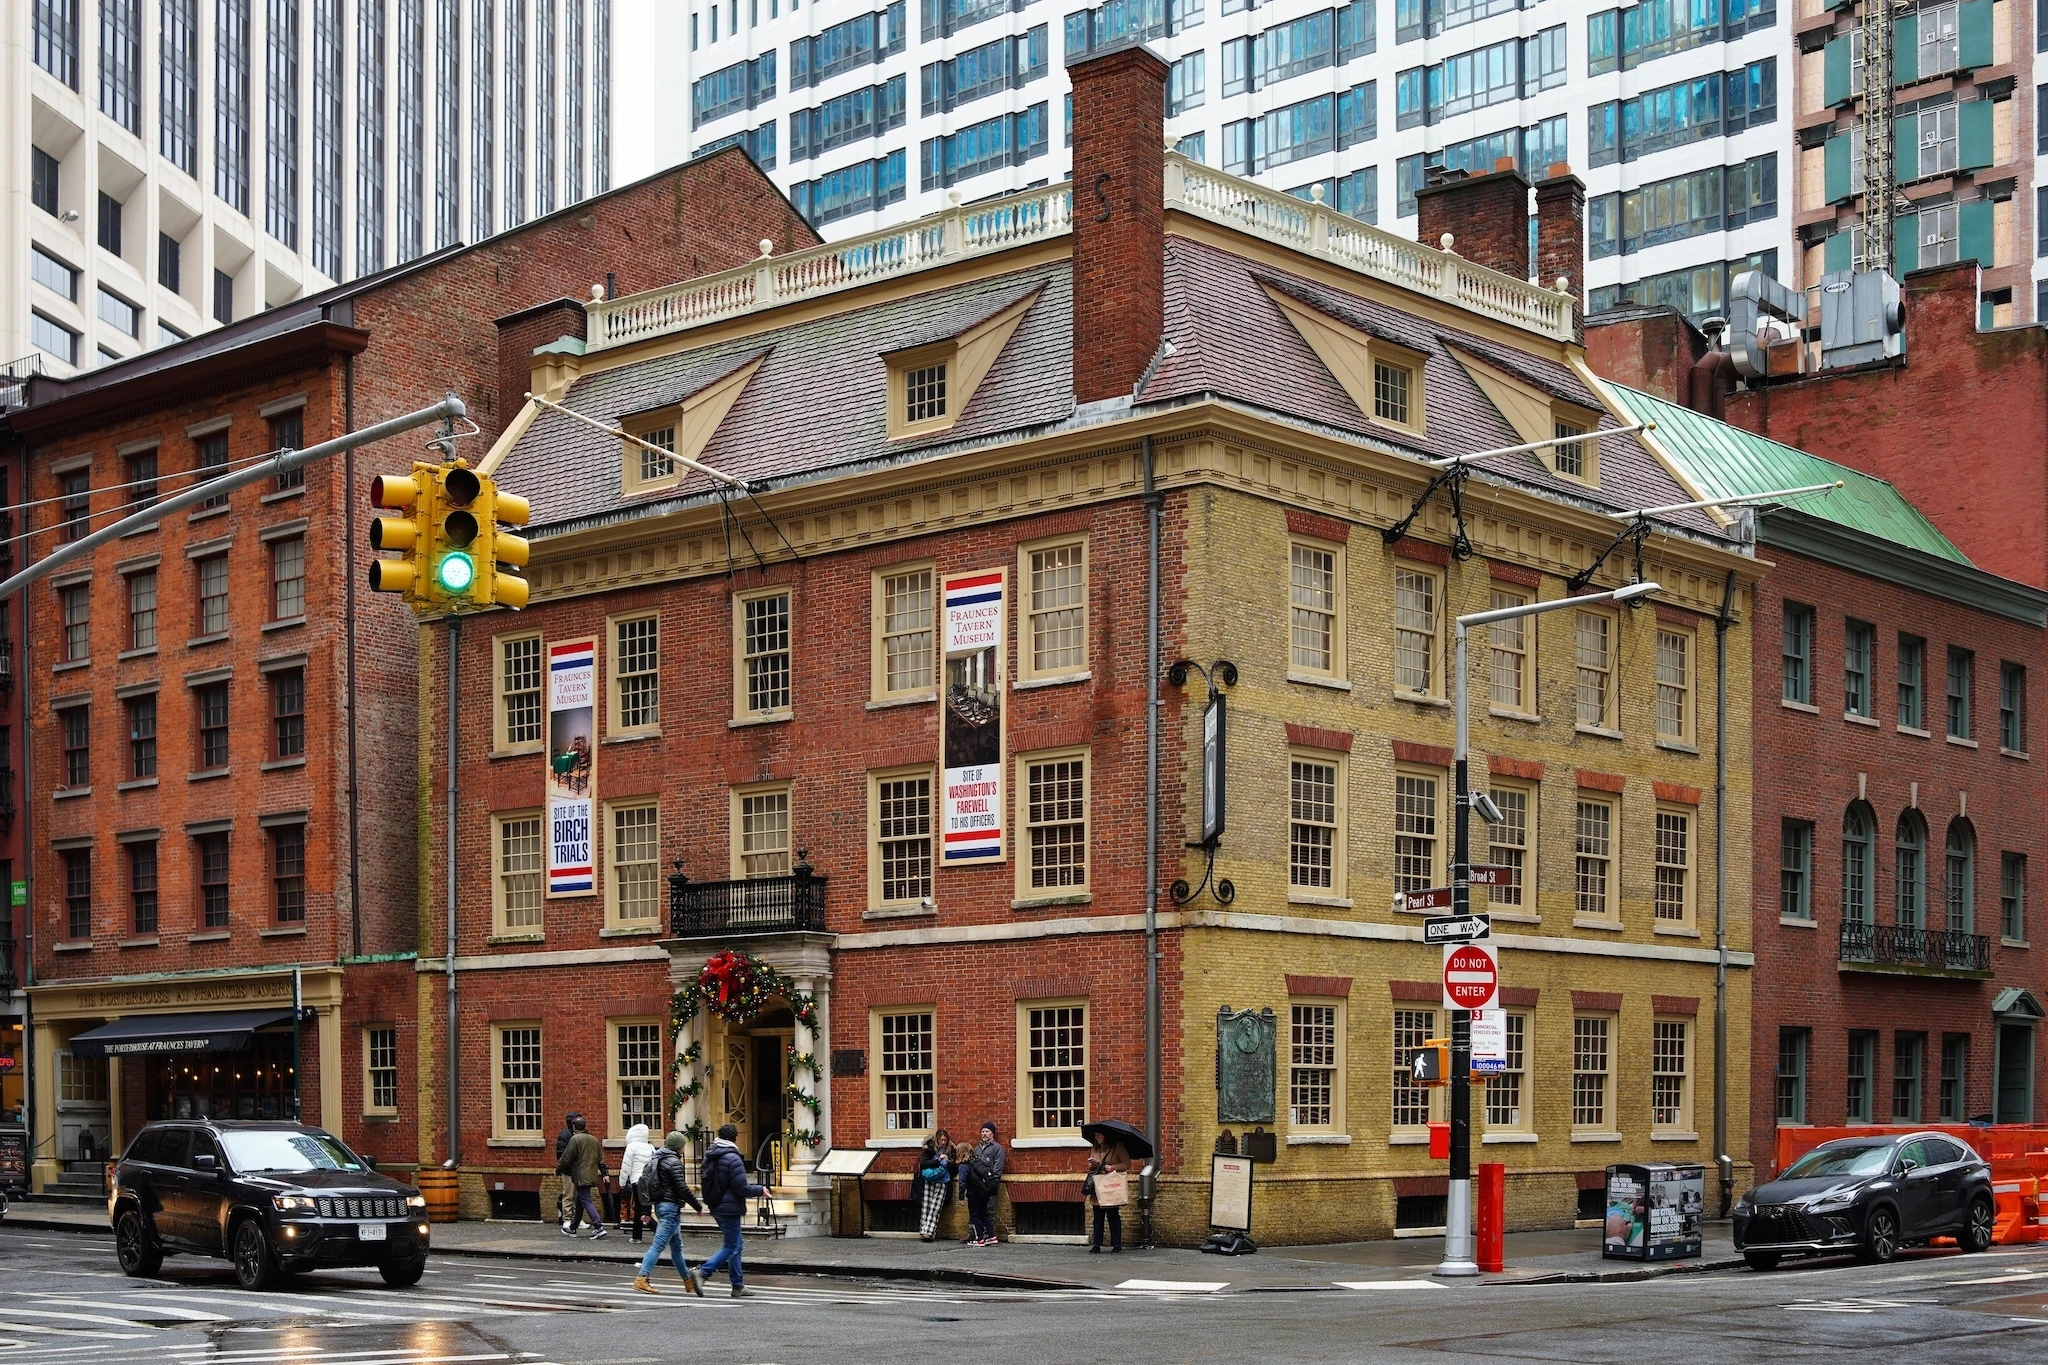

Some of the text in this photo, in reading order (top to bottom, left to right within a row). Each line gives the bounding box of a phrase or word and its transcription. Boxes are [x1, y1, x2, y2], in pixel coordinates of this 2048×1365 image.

[950, 607, 998, 621] FRAUNCES
[953, 632, 994, 645] MUSEUM
[554, 671, 591, 683] FRAUNCES
[556, 694, 588, 705] MUSEUM
[962, 769, 983, 782] SITE OF
[949, 782, 997, 799] WASHINGTON'S
[554, 804, 588, 820] SITE OF THE
[957, 799, 989, 814] FAREWELL
[951, 814, 995, 829] TO HIS OFFICERS
[554, 818, 588, 844] BIRCH
[554, 842, 588, 863] TRIALS
[1470, 870, 1496, 883] Broad St
[1408, 894, 1434, 909] Pearl St
[1430, 922, 1481, 935] ONE WAY
[1453, 958, 1487, 969] DO NOT
[79, 981, 293, 1008] THE PORTERHOUSE AT FRAUNCES TAVERN
[1455, 986, 1485, 997] ENTER
[1474, 1010, 1480, 1020] 3
[104, 1044, 114, 1053] THE
[114, 1042, 149, 1053] PORTERHOUSE
[149, 1041, 156, 1050] AT
[156, 1040, 184, 1050] FRAUNCES
[0, 1057, 15, 1067] OPEN
[1651, 1207, 1676, 1217] BIG CITIES
[1650, 1214, 1686, 1225] RUN ON SMALL
[1650, 1223, 1680, 1233] BUSINESSES
